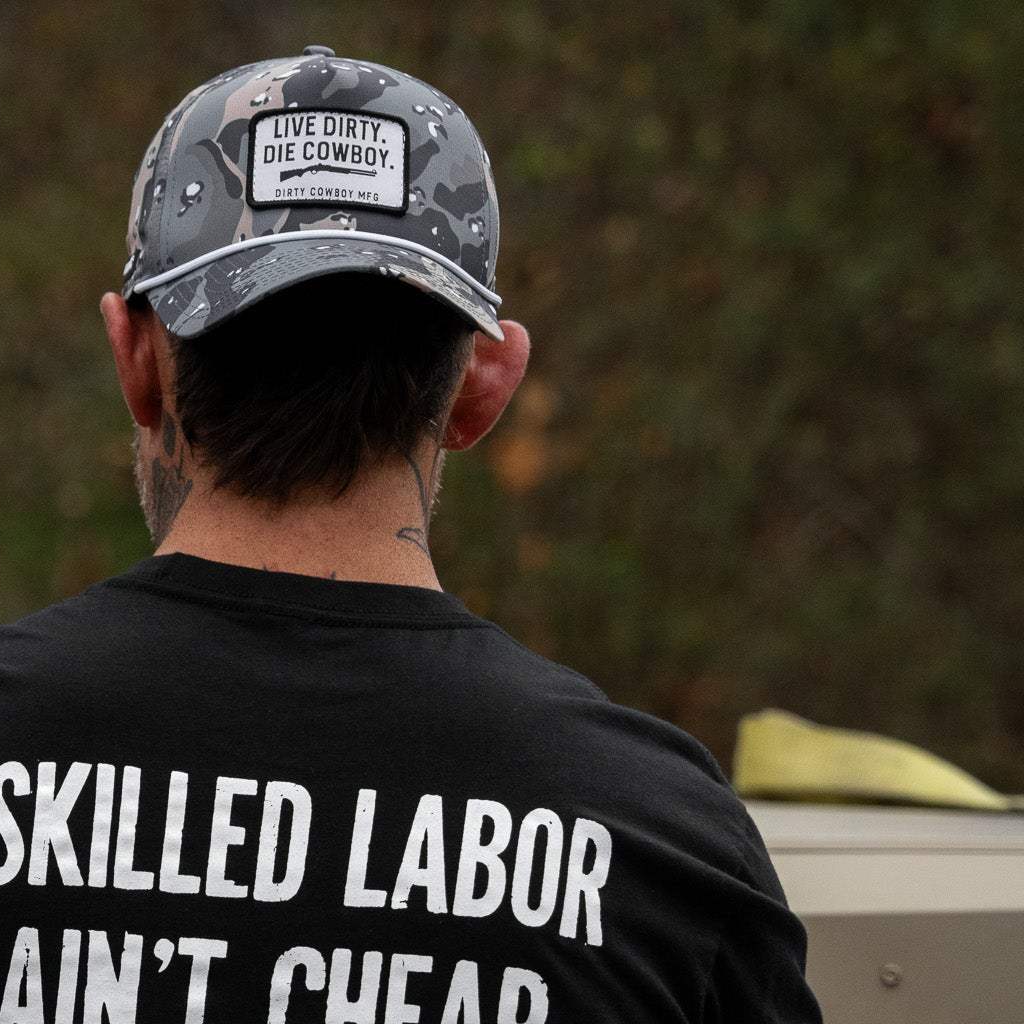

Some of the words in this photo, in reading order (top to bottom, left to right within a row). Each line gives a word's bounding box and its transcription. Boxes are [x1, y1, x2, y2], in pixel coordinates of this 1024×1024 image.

[273, 115, 317, 139] LIVE
[323, 115, 387, 144] DIRTY.
[263, 142, 296, 164] DIE
[302, 141, 395, 170] COWBOY.
[275, 187, 305, 198] DIRTY
[309, 186, 354, 199] COWBOY
[358, 190, 379, 201] MFG
[344, 789, 612, 946] LABOR
